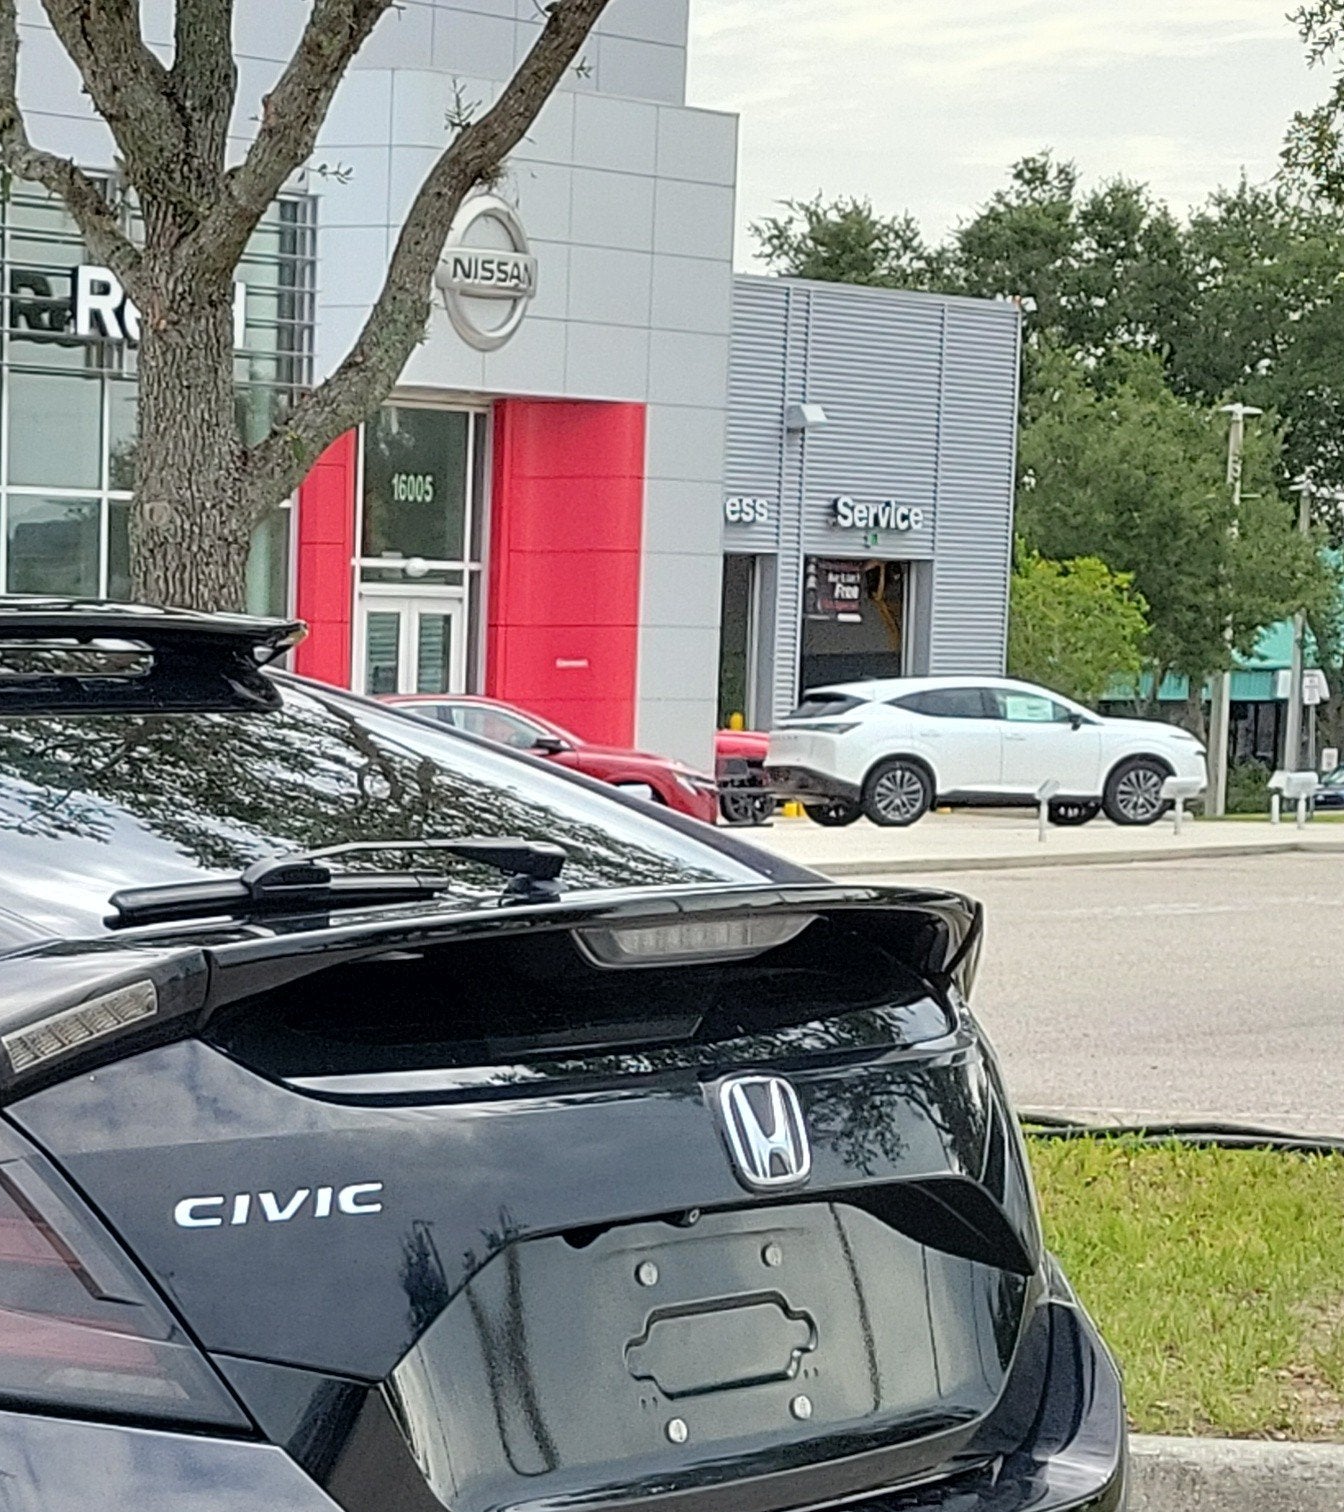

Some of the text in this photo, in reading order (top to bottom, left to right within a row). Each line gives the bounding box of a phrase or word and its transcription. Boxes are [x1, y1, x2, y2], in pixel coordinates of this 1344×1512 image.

[392, 472, 433, 502] 16005
[836, 496, 923, 529] Service
[174, 1182, 384, 1228] CIVIC
